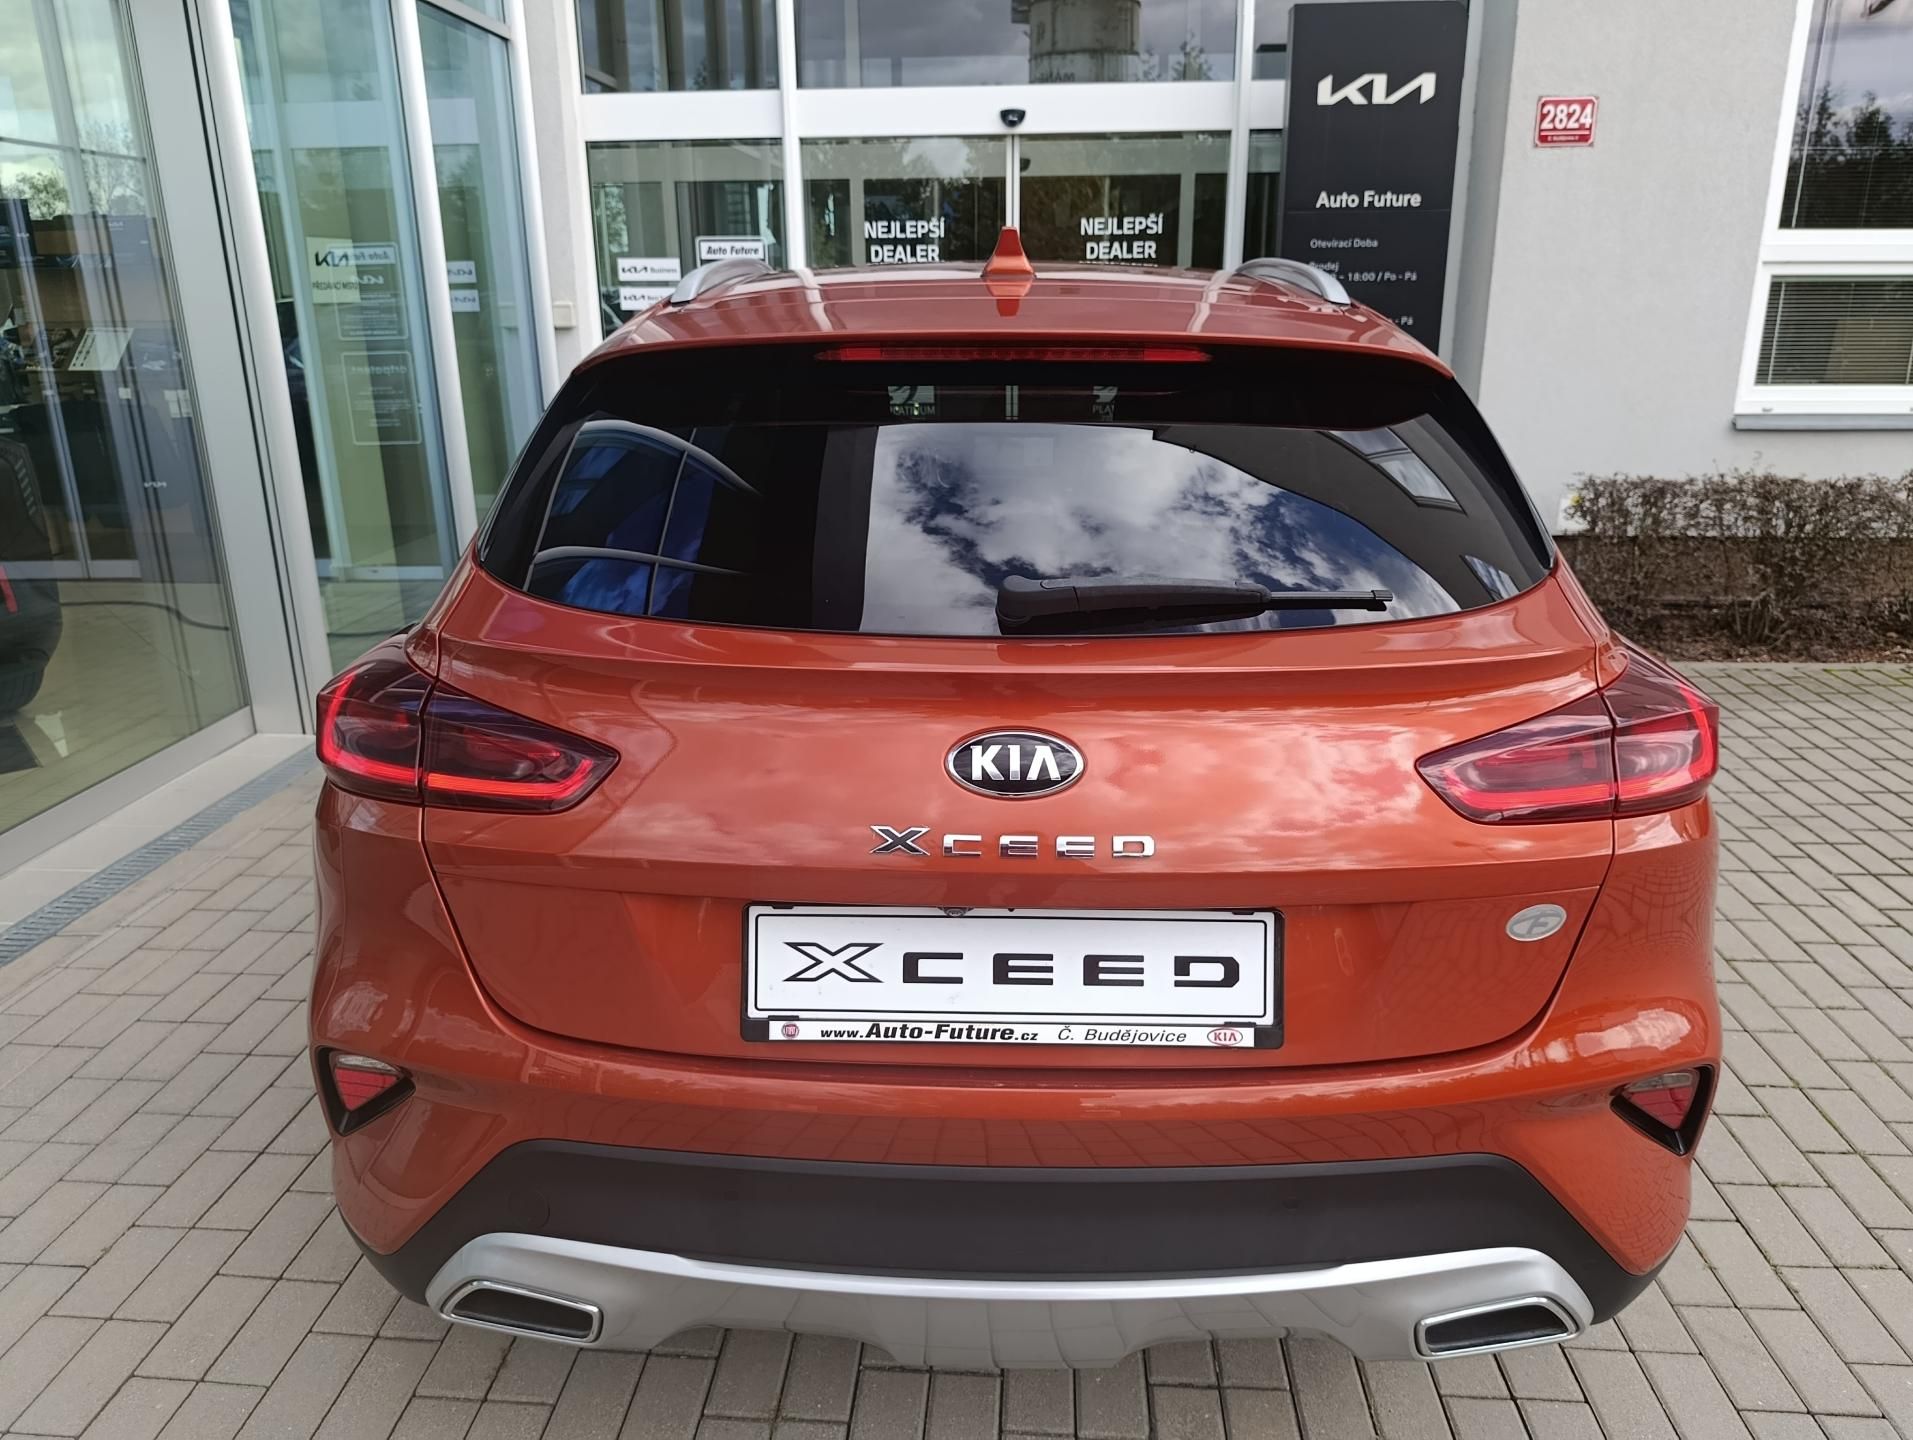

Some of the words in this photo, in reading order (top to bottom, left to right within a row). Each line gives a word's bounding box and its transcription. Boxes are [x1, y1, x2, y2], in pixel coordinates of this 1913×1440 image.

[1317, 72, 1436, 105] KIA
[1540, 103, 1593, 129] 2824
[1316, 190, 1359, 208] Auto
[1363, 190, 1422, 208] Future
[864, 216, 945, 239] NEJLEPŠÍ
[1080, 213, 1164, 236] NEJLEPŠÍ
[707, 246, 728, 256] Auto
[730, 246, 760, 256] Future
[870, 244, 940, 263] DEALER
[1086, 241, 1157, 260] DEALER
[1353, 237, 1379, 248] Doba
[1348, 271, 1377, 282] 18:00
[970, 744, 1062, 781] KIA
[869, 825, 1156, 858] XCEED
[782, 941, 1240, 988] XCEED
[820, 1022, 1038, 1042] www.Auto-Future.cz
[1057, 1025, 1074, 1041] Č.
[1084, 1027, 1187, 1044] Budějovice
[1213, 1031, 1238, 1042] KIA
